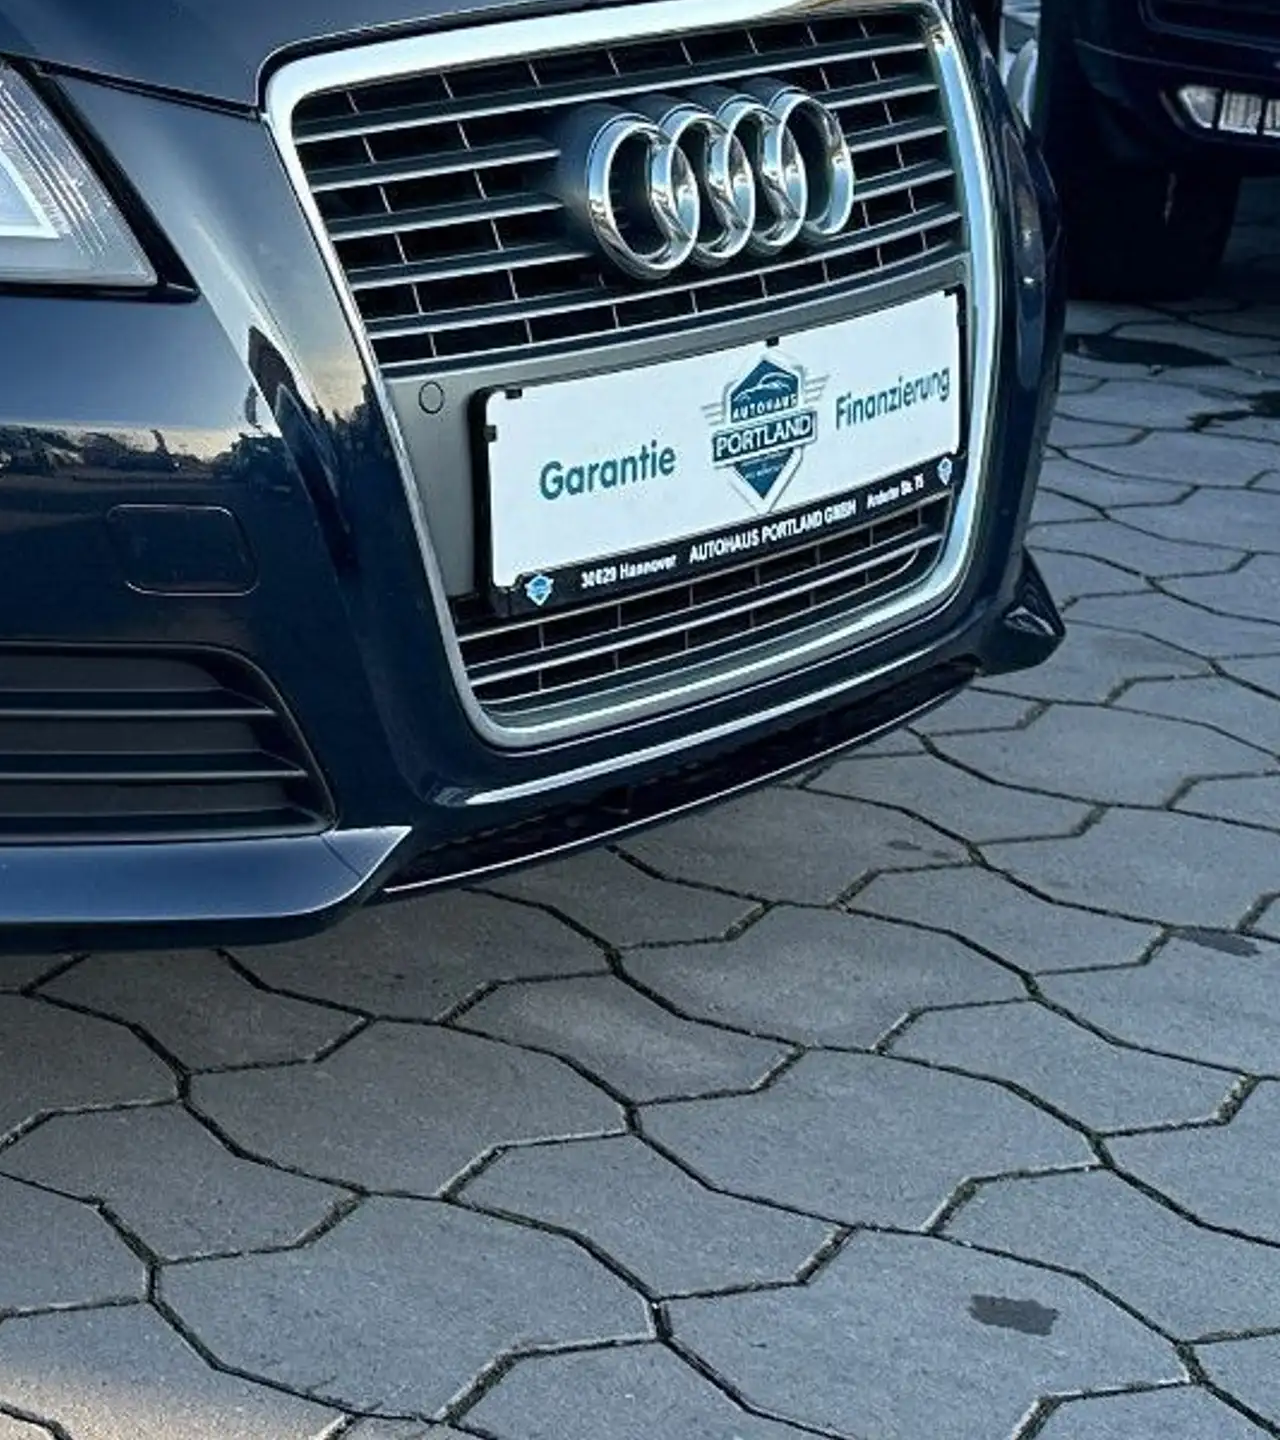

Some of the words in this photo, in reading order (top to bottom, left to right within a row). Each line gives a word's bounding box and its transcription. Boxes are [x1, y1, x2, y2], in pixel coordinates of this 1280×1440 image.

[835, 367, 951, 431] Finanzierung
[715, 415, 812, 457] PORTLAND
[540, 440, 676, 500] Garantie
[619, 554, 677, 580] Hannover
[689, 527, 760, 564] AUTOHAUS
[761, 510, 823, 544] PORTLAND
